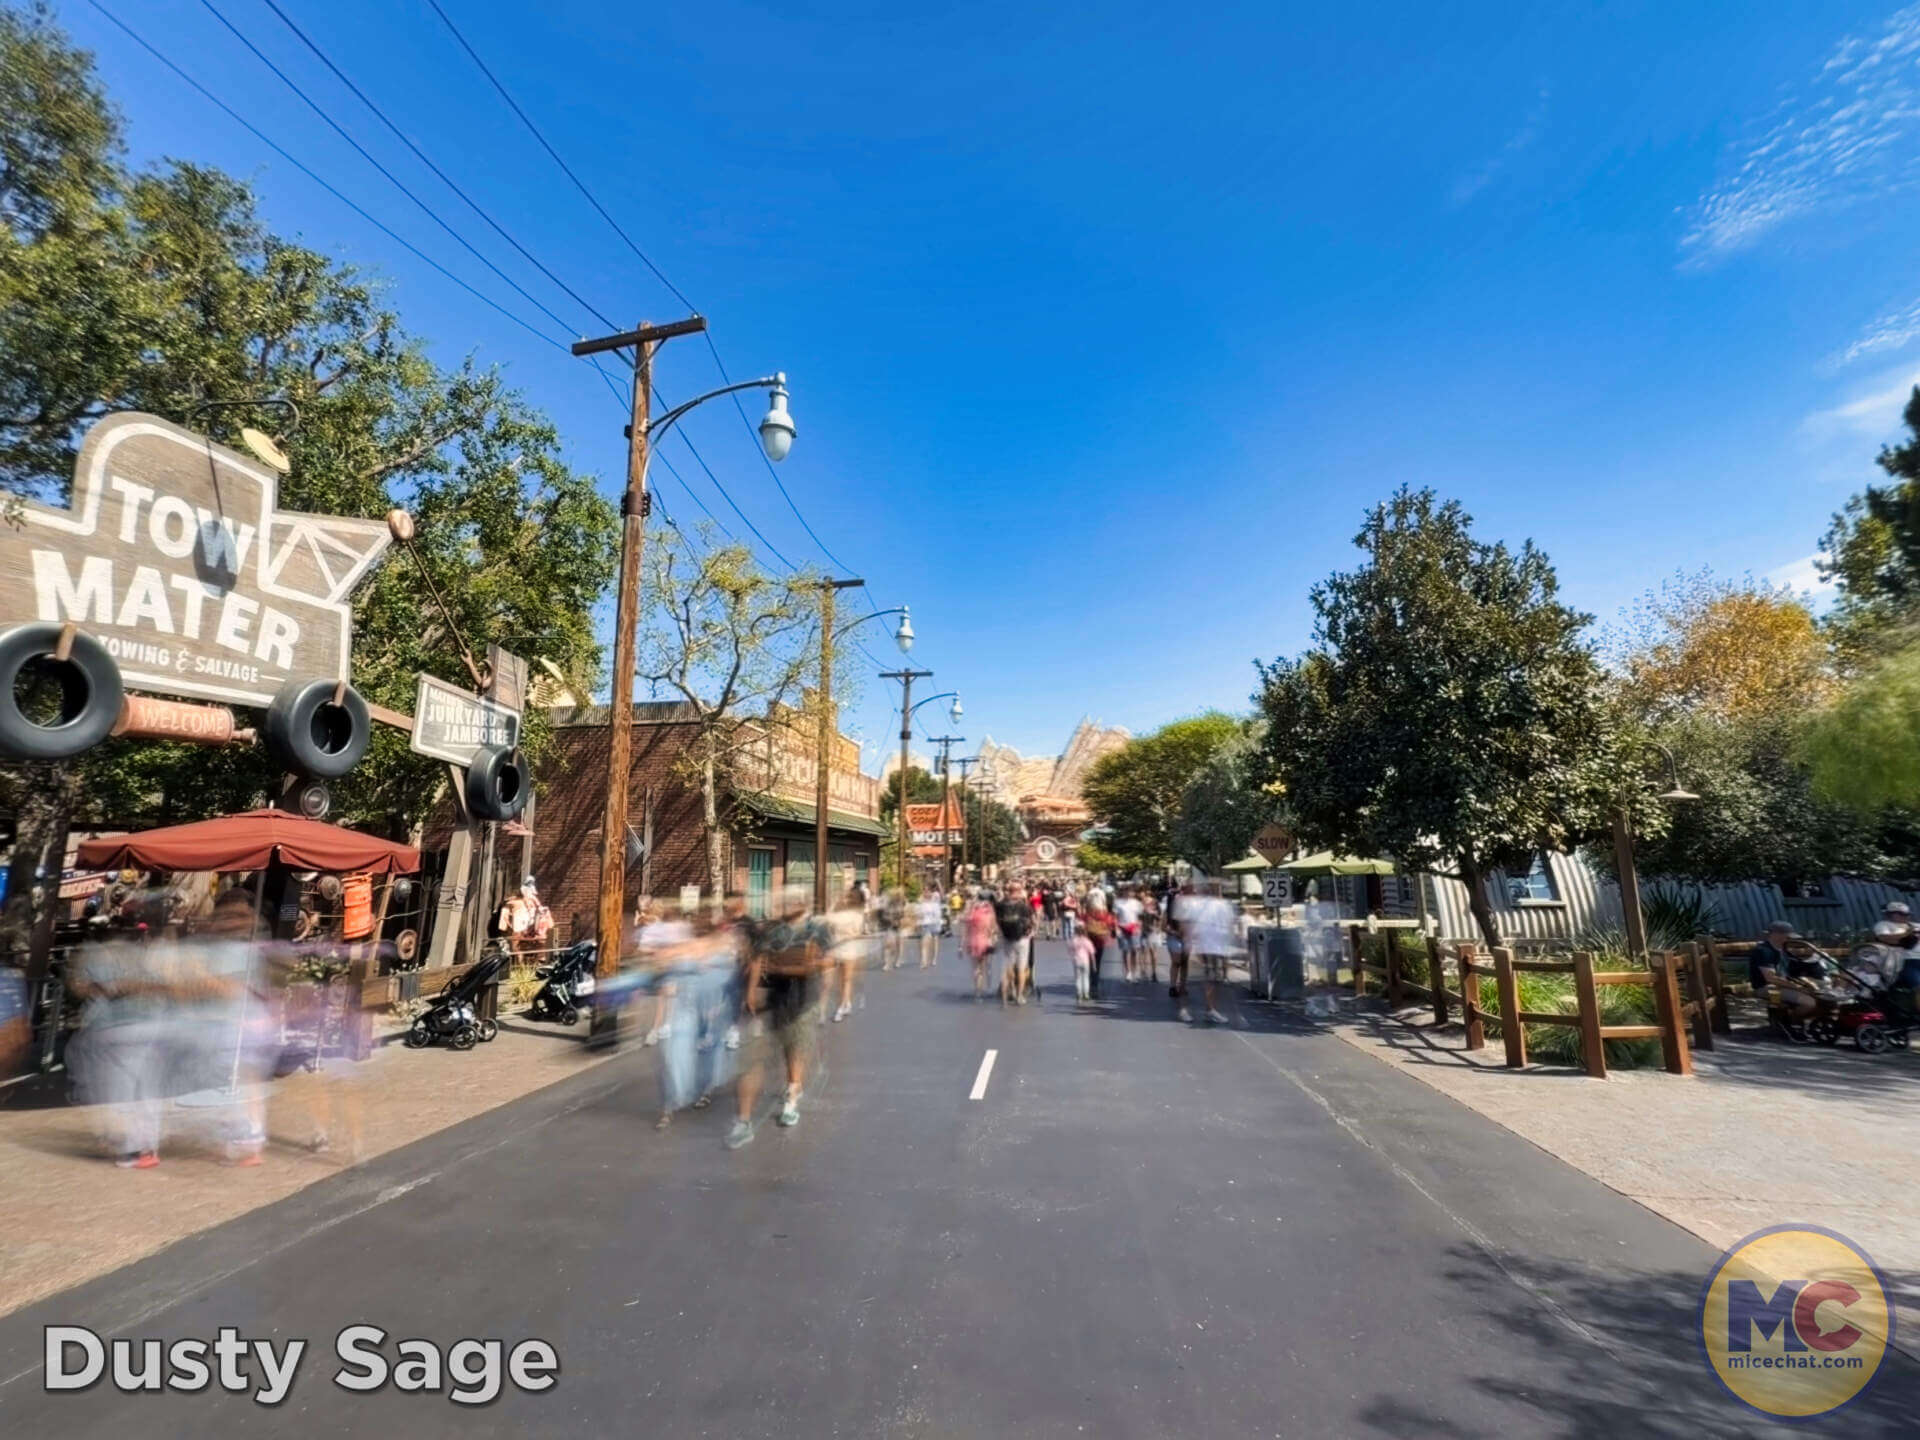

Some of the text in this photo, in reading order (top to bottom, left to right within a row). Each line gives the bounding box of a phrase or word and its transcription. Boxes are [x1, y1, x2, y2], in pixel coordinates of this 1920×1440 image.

[111, 475, 256, 573] TOW
[31, 549, 301, 671] MATER
[98, 635, 259, 683] TOWING & SALVAGE
[137, 705, 226, 737] WELCOME
[428, 704, 497, 727] JUNKYARD
[444, 724, 510, 745] JAMBOREE
[912, 831, 963, 842] MOTEL
[1257, 838, 1289, 849] SLOW
[1266, 880, 1288, 898] 25
